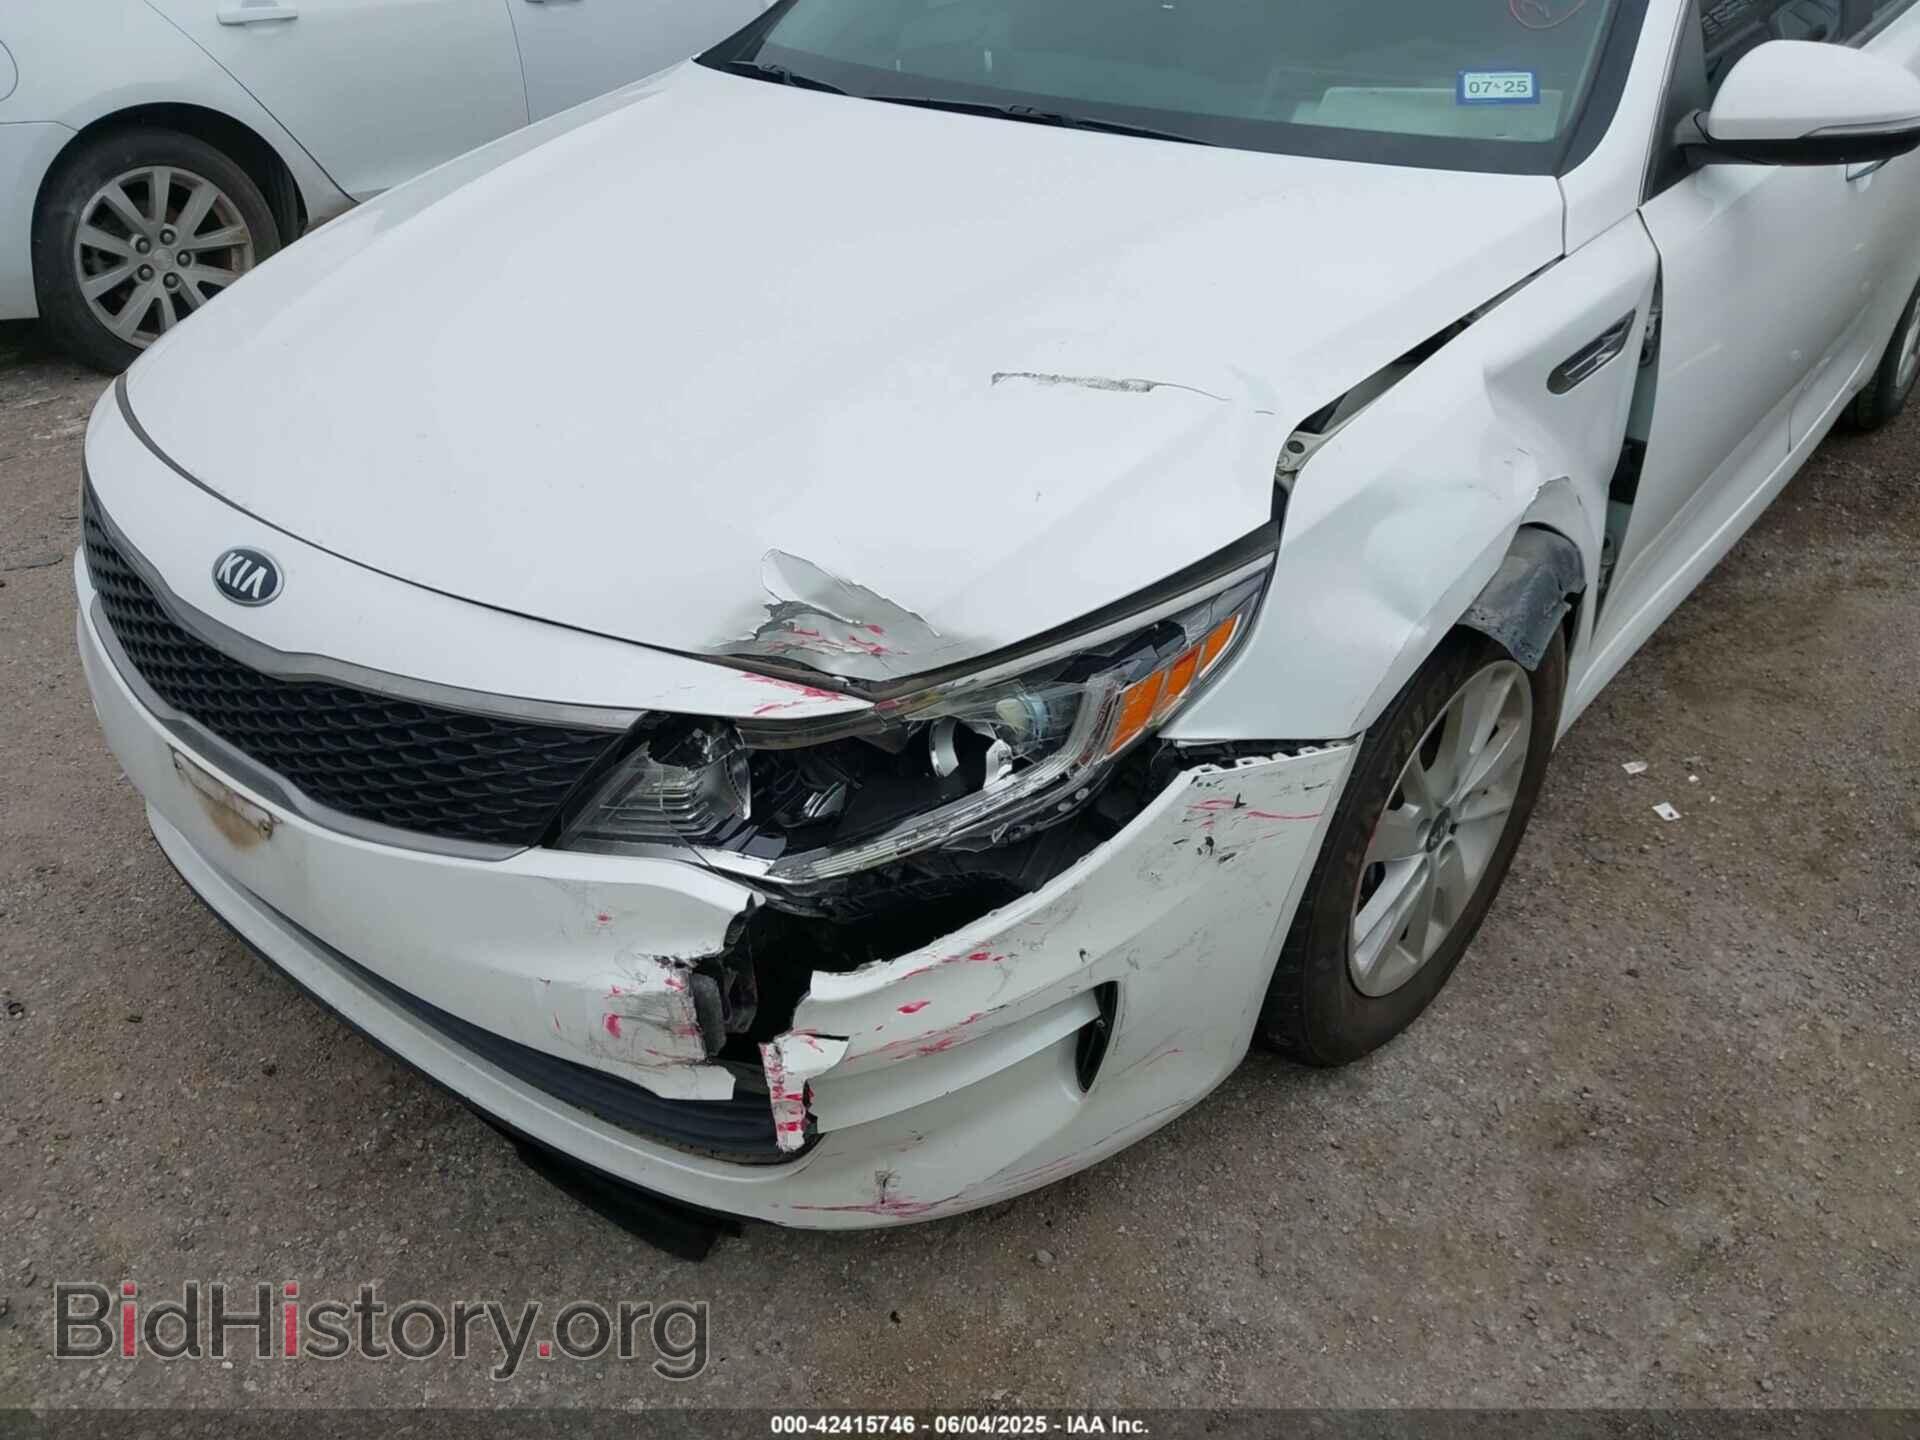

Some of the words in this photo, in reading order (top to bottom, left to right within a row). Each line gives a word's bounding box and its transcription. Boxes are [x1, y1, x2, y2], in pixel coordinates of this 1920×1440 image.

[1469, 81, 1492, 94] 07
[1503, 80, 1528, 93] 25
[216, 552, 268, 599] KIA
